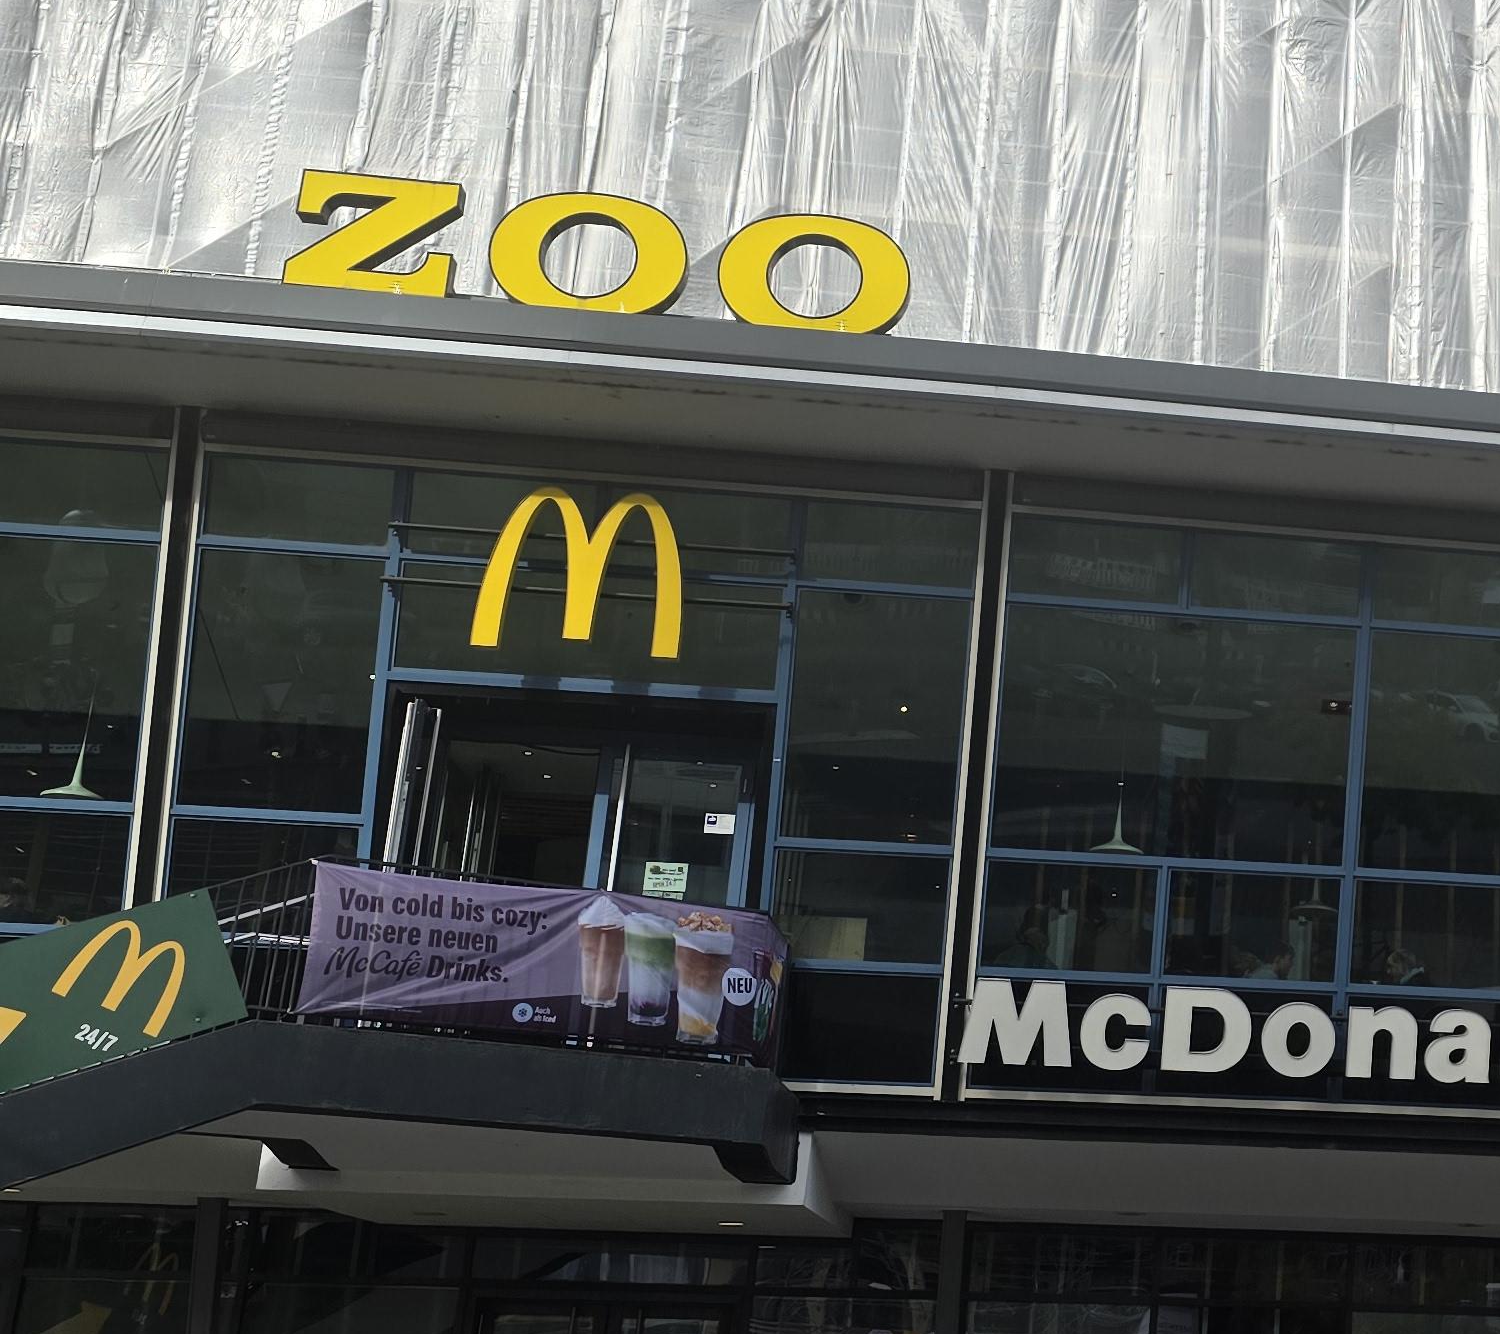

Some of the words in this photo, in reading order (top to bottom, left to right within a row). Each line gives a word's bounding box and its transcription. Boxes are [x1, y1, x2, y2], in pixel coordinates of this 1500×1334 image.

[283, 168, 911, 334] ZOO
[339, 887, 384, 914] Von
[391, 893, 443, 919] cold
[451, 898, 484, 924] bis
[491, 906, 549, 936] cozy:
[335, 914, 421, 947] Unsere
[428, 927, 498, 954] neuen
[323, 946, 424, 981] McCafé
[426, 954, 509, 984] Drinks.
[727, 977, 753, 994] NEU
[74, 1023, 119, 1052] 24/7
